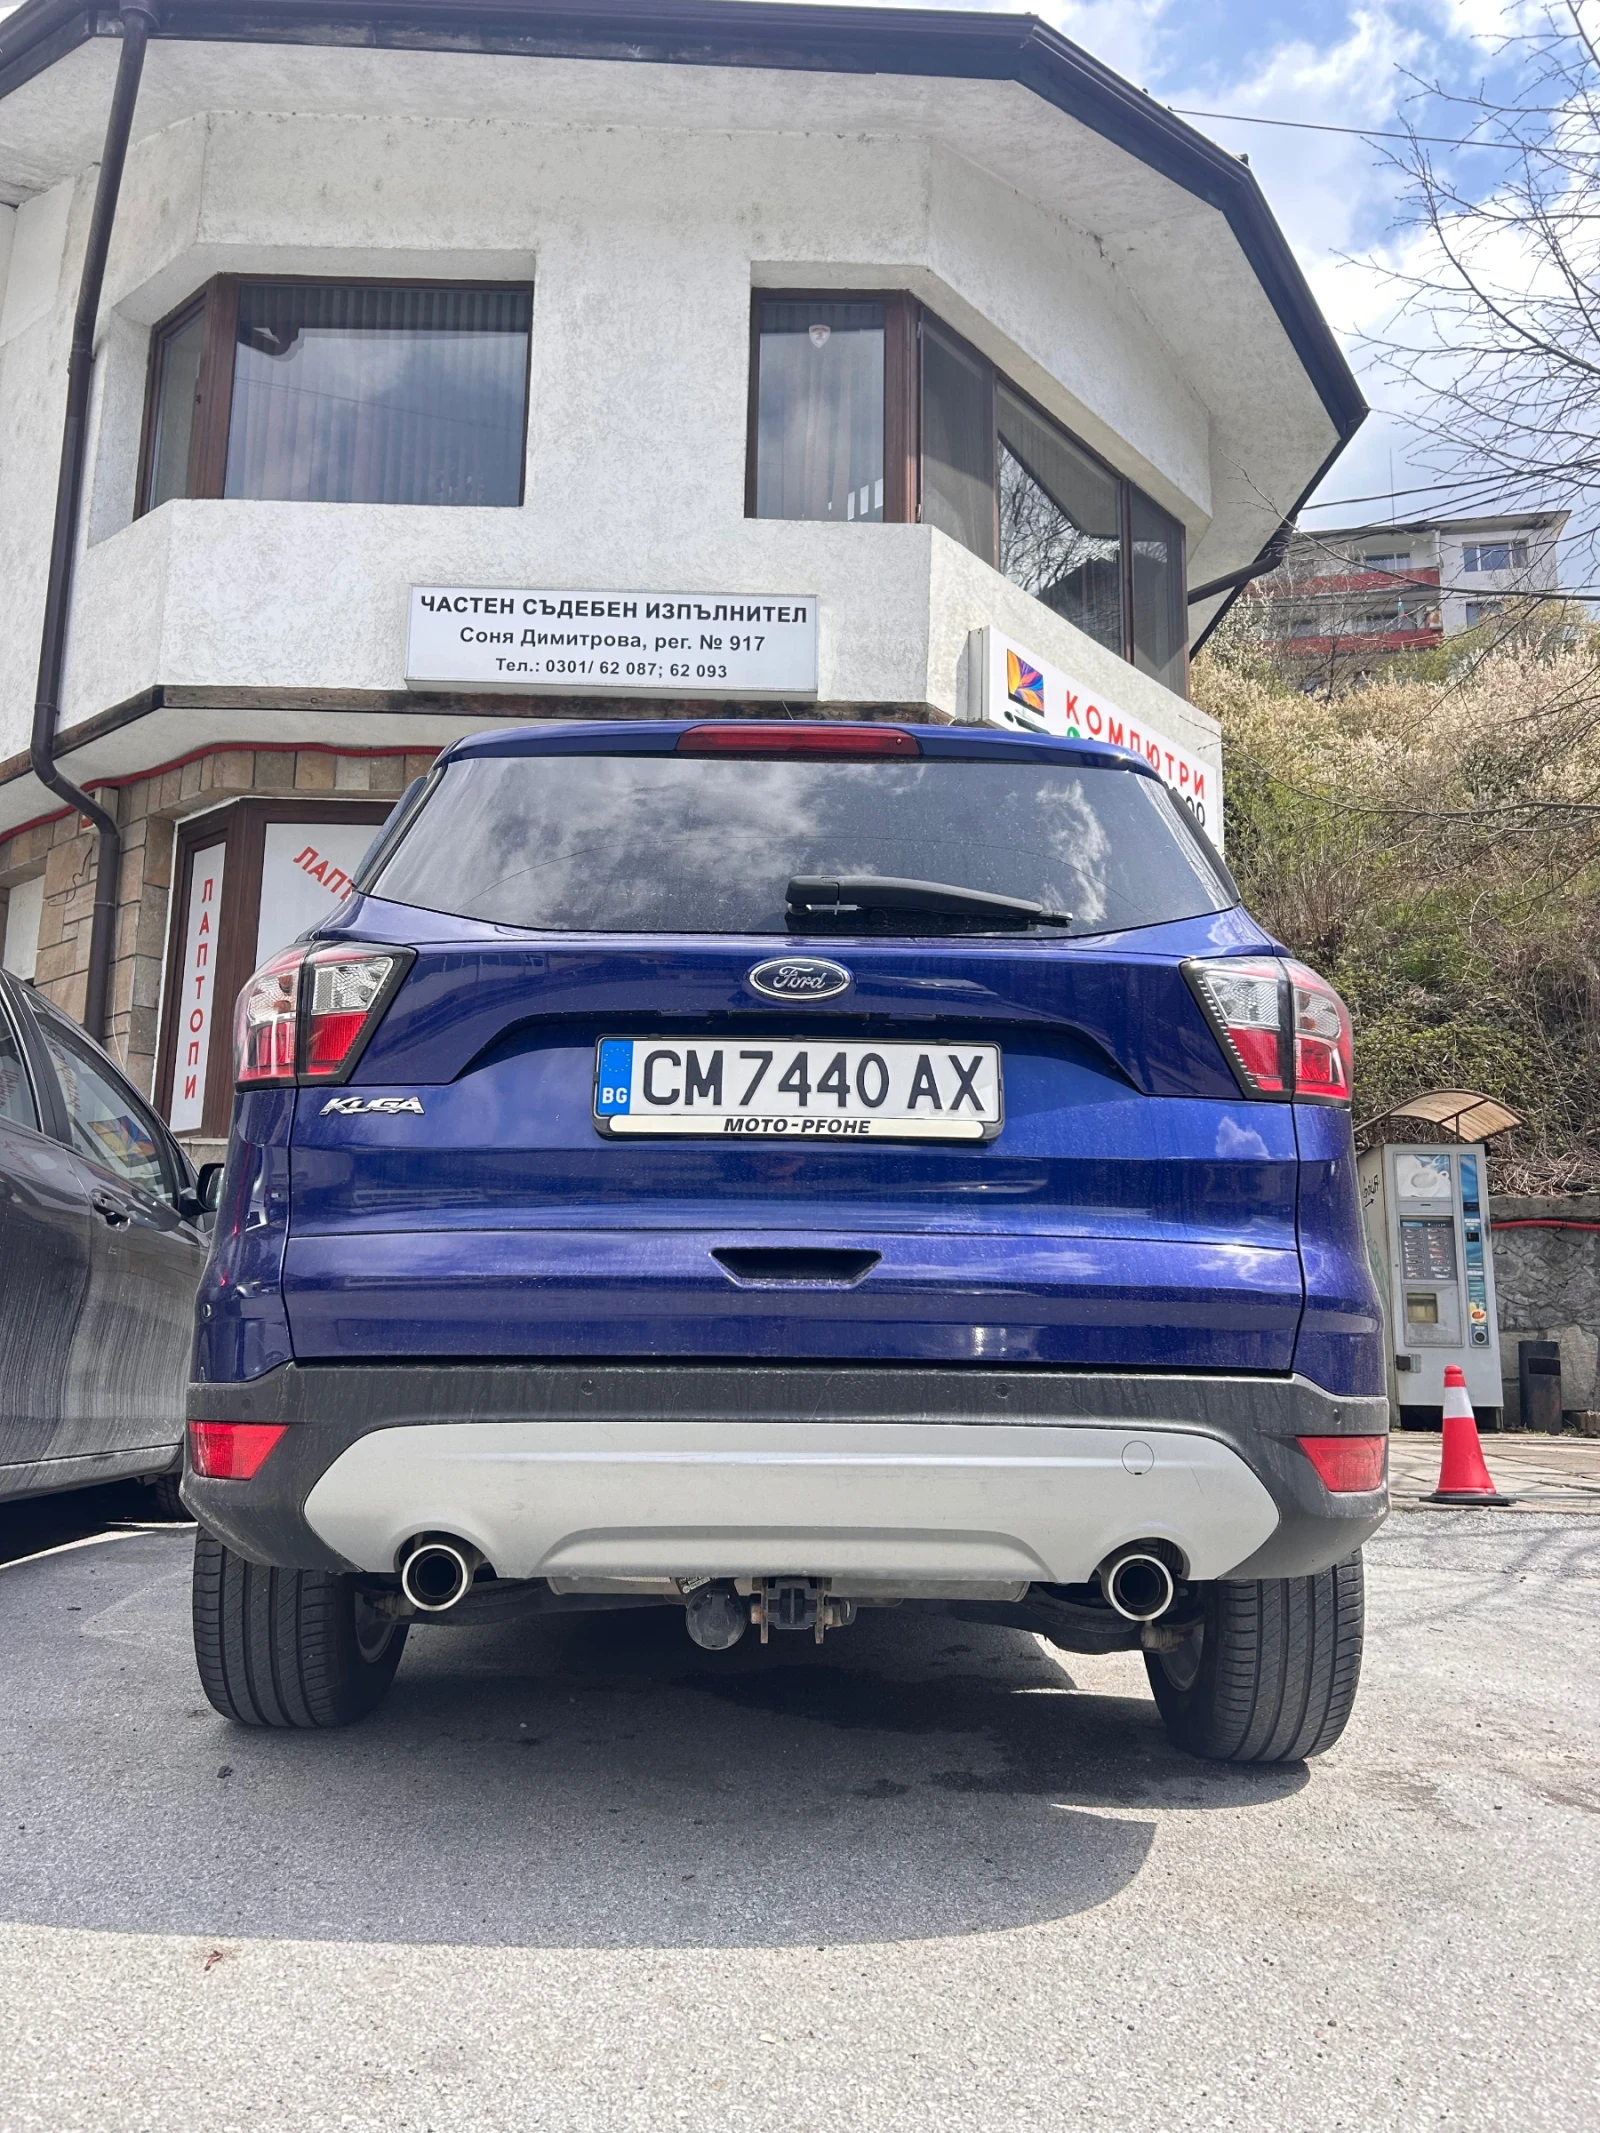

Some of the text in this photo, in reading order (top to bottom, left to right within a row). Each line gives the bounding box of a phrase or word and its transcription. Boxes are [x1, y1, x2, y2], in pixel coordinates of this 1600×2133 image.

[421, 595, 807, 623] ЧАСТЕН СЪДЕБЕН ИЗПЪЛНИТЕЛ
[460, 626, 765, 652] Соня Димитрова, рег. № 917
[495, 658, 727, 678] Тел.: 0301/ 62 087; 62 093
[1066, 690, 1206, 800] КОМПЮТРИ
[184, 878, 213, 1099] ЛАПТОПИ
[772, 966, 827, 990] Ford
[738, 1050, 890, 1109] 7440
[319, 1096, 425, 1116] KUGA
[602, 1088, 628, 1104] BG
[723, 1117, 871, 1135] MOTO-PFOHE
